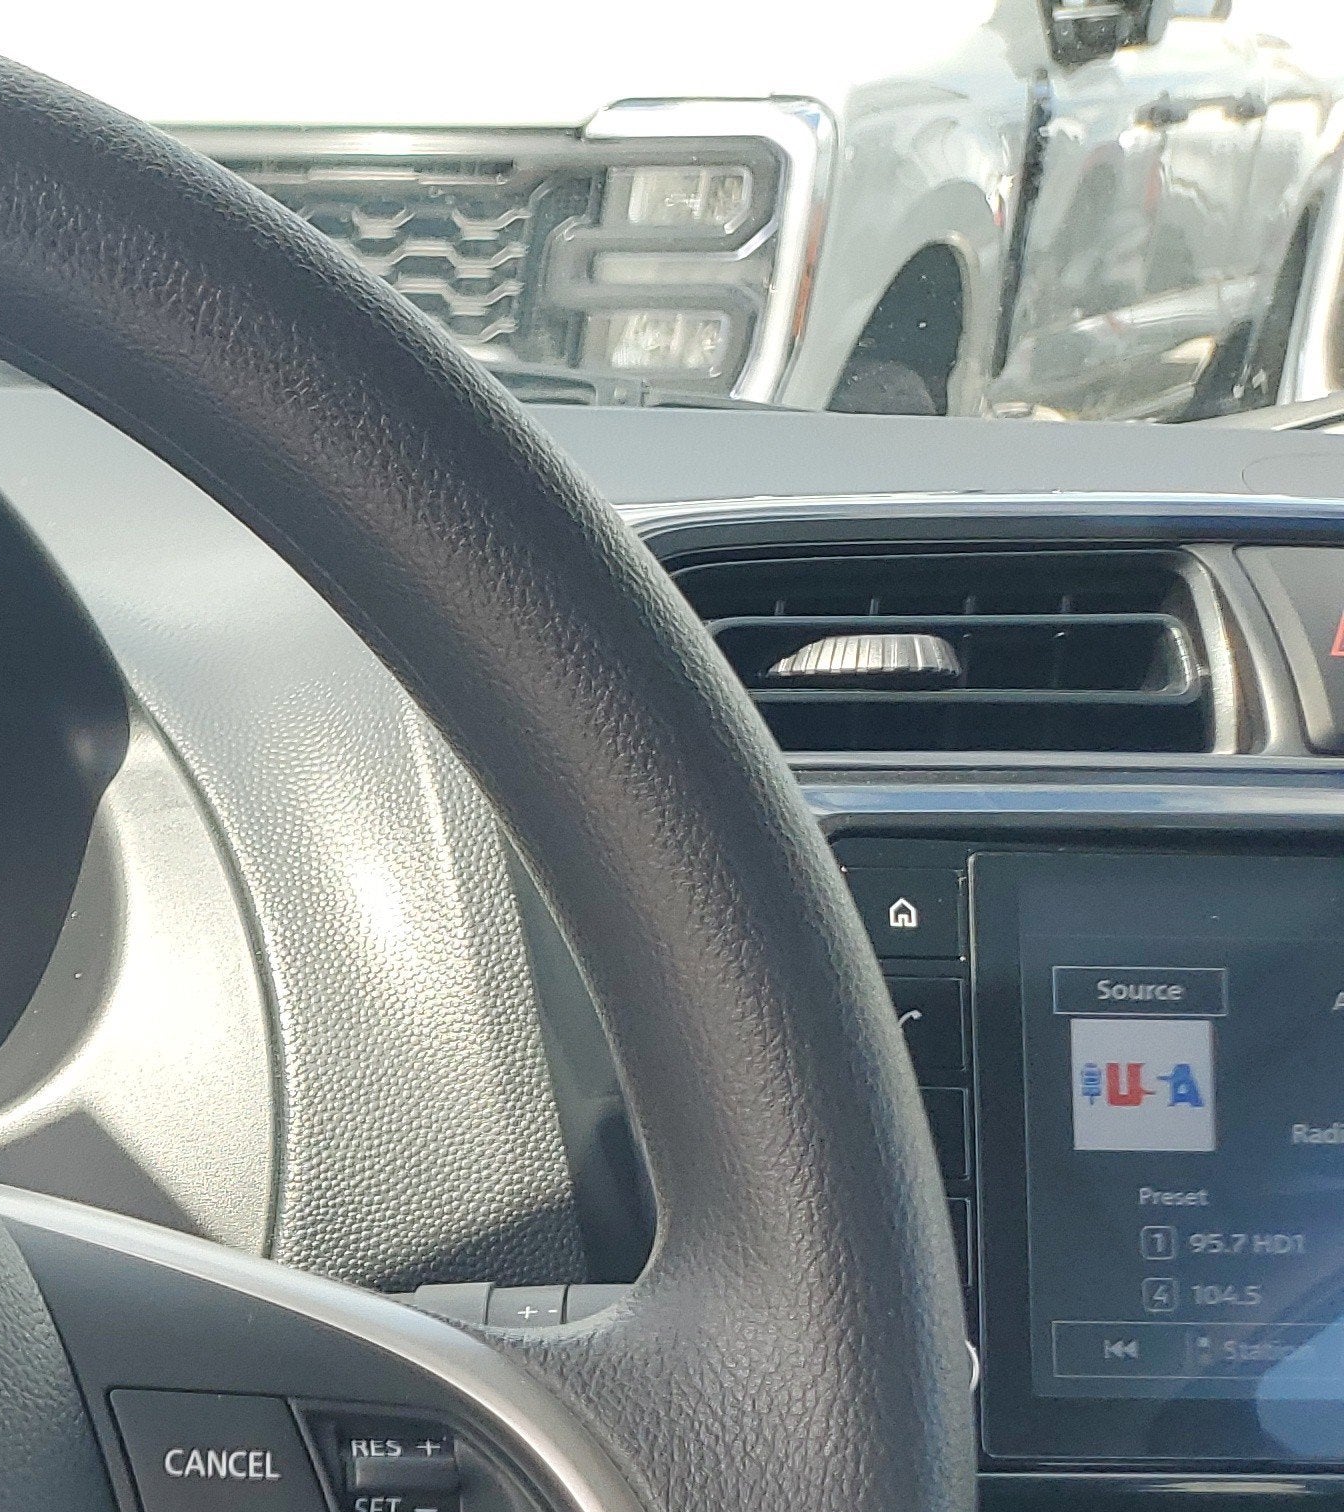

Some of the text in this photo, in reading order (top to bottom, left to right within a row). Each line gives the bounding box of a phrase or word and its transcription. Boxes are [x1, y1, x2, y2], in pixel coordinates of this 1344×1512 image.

[1096, 979, 1184, 1003] Source
[1138, 1187, 1210, 1208] Preset
[1151, 1232, 1164, 1254] 1
[1188, 1232, 1247, 1254] 95.7
[1191, 1284, 1263, 1306] 104.5
[351, 1438, 402, 1458] RES
[164, 1448, 281, 1480] CANCEL
